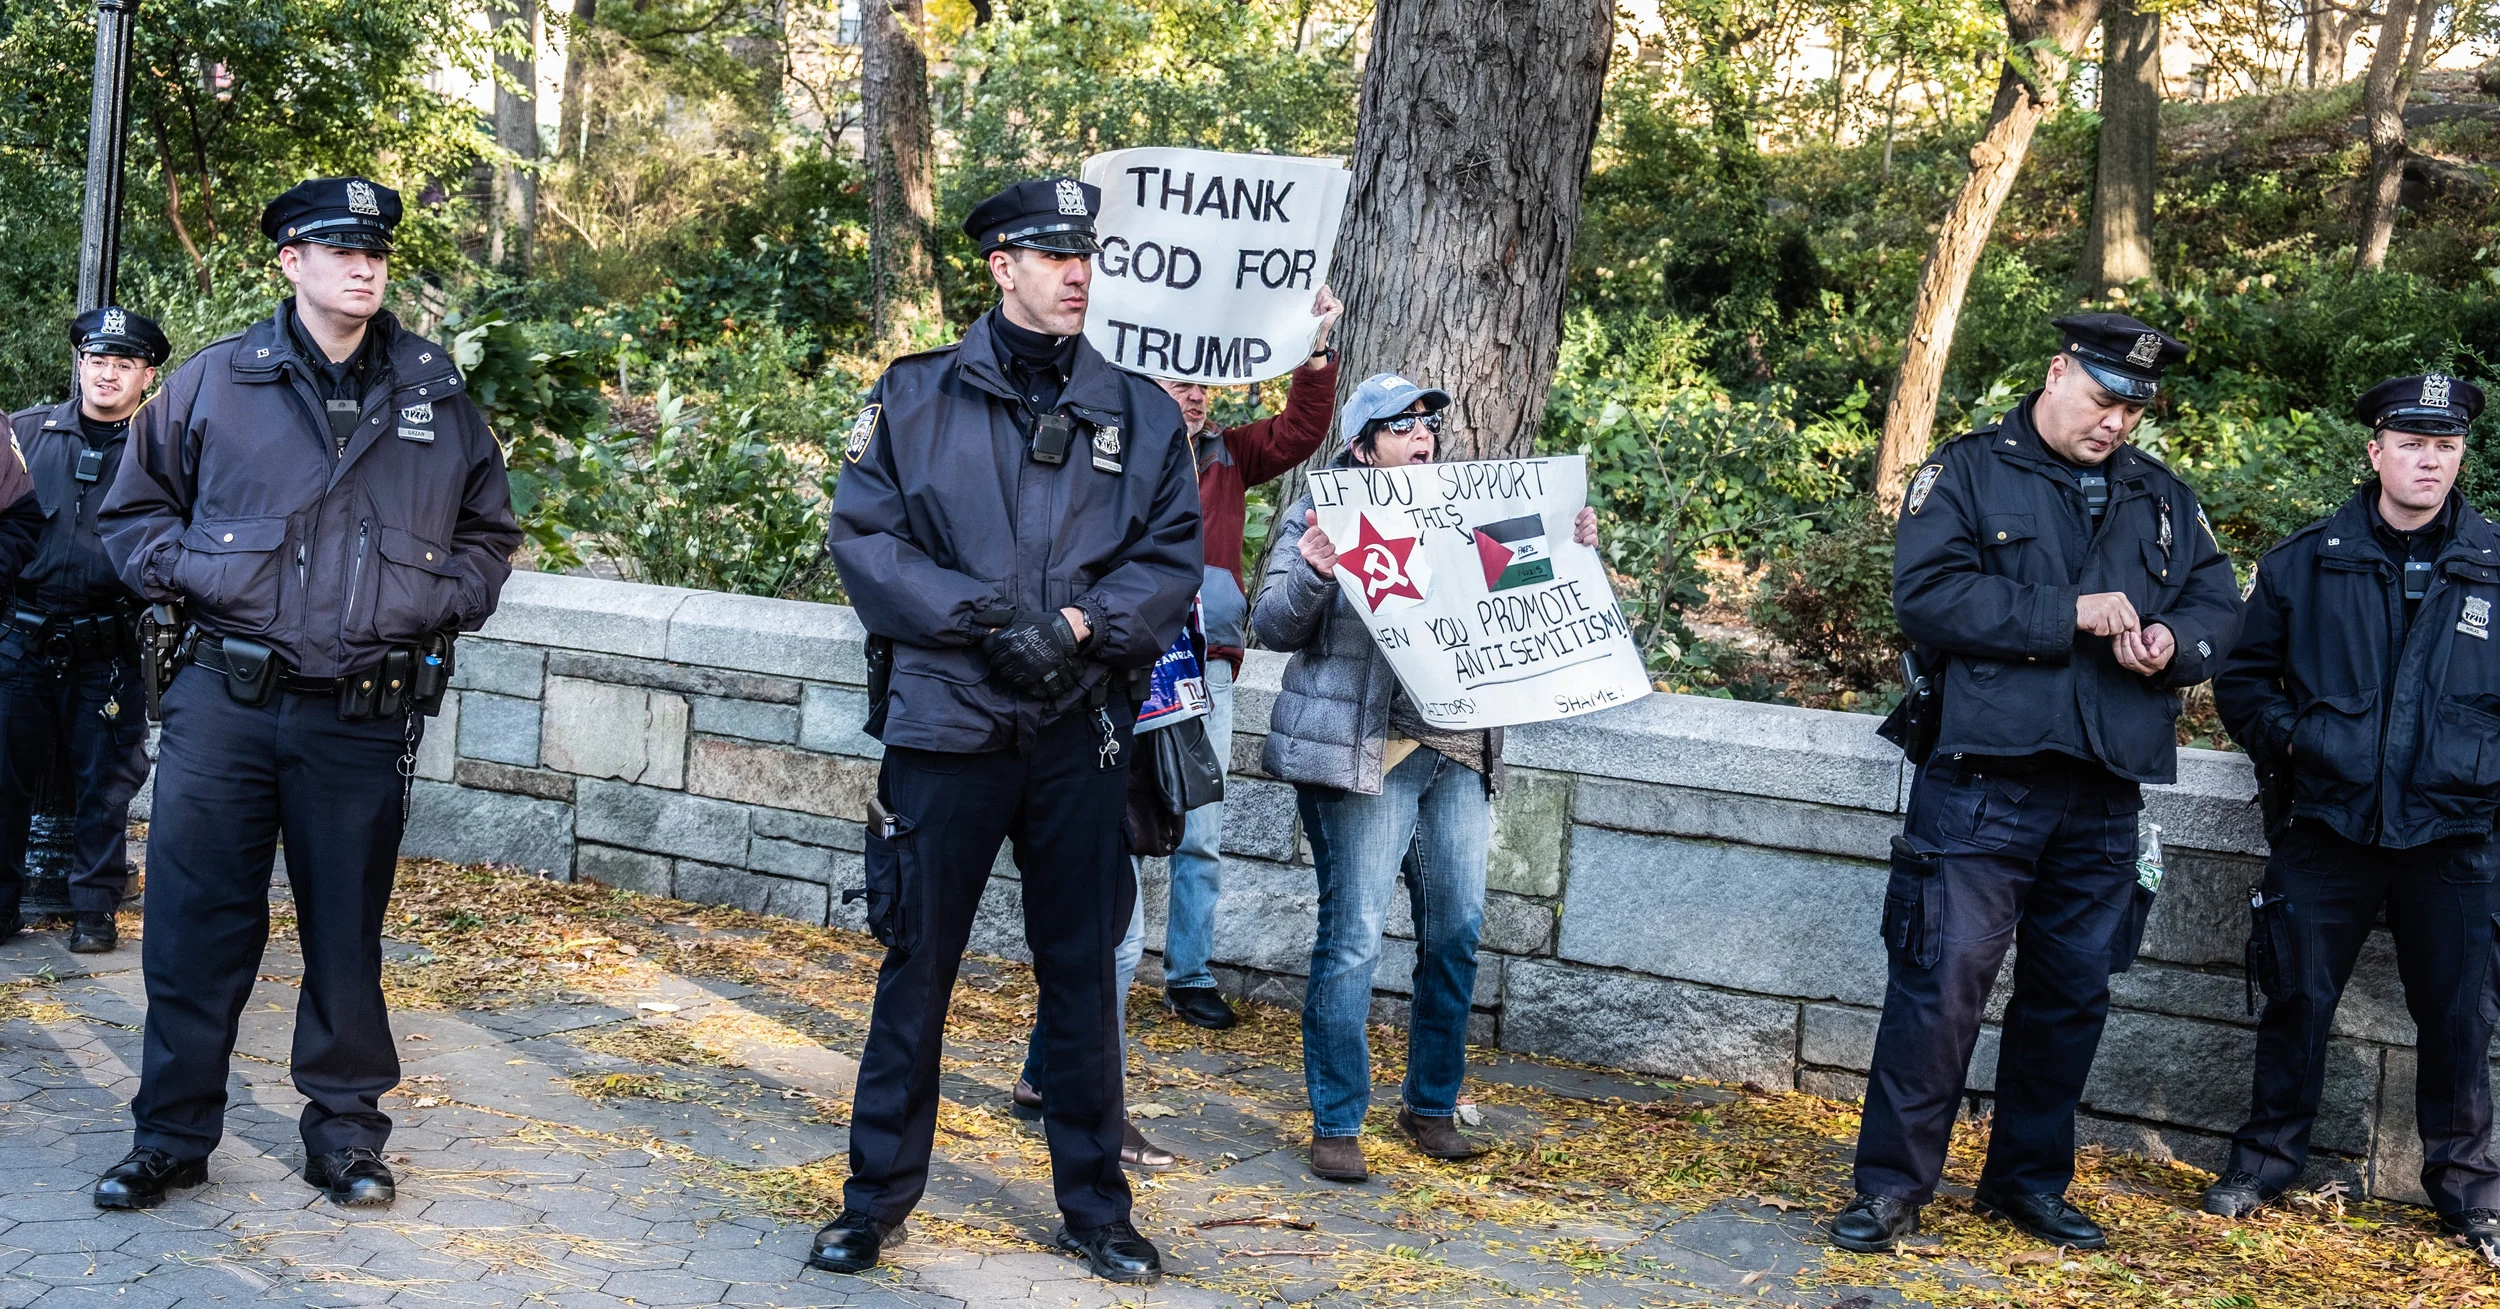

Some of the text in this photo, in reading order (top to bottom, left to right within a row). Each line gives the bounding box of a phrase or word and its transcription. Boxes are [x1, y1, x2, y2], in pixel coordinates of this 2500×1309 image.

[1126, 166, 1295, 223] THANK
[1099, 235, 1317, 290] GOD FOR
[1107, 319, 1272, 378] TRUMP
[1310, 461, 1548, 507] IF YOU SUPPORT
[1404, 504, 1463, 529] THIS
[1376, 580, 1590, 649] HEN YOU PROMOTE
[1424, 685, 1626, 716] AITORS! SHAME!
